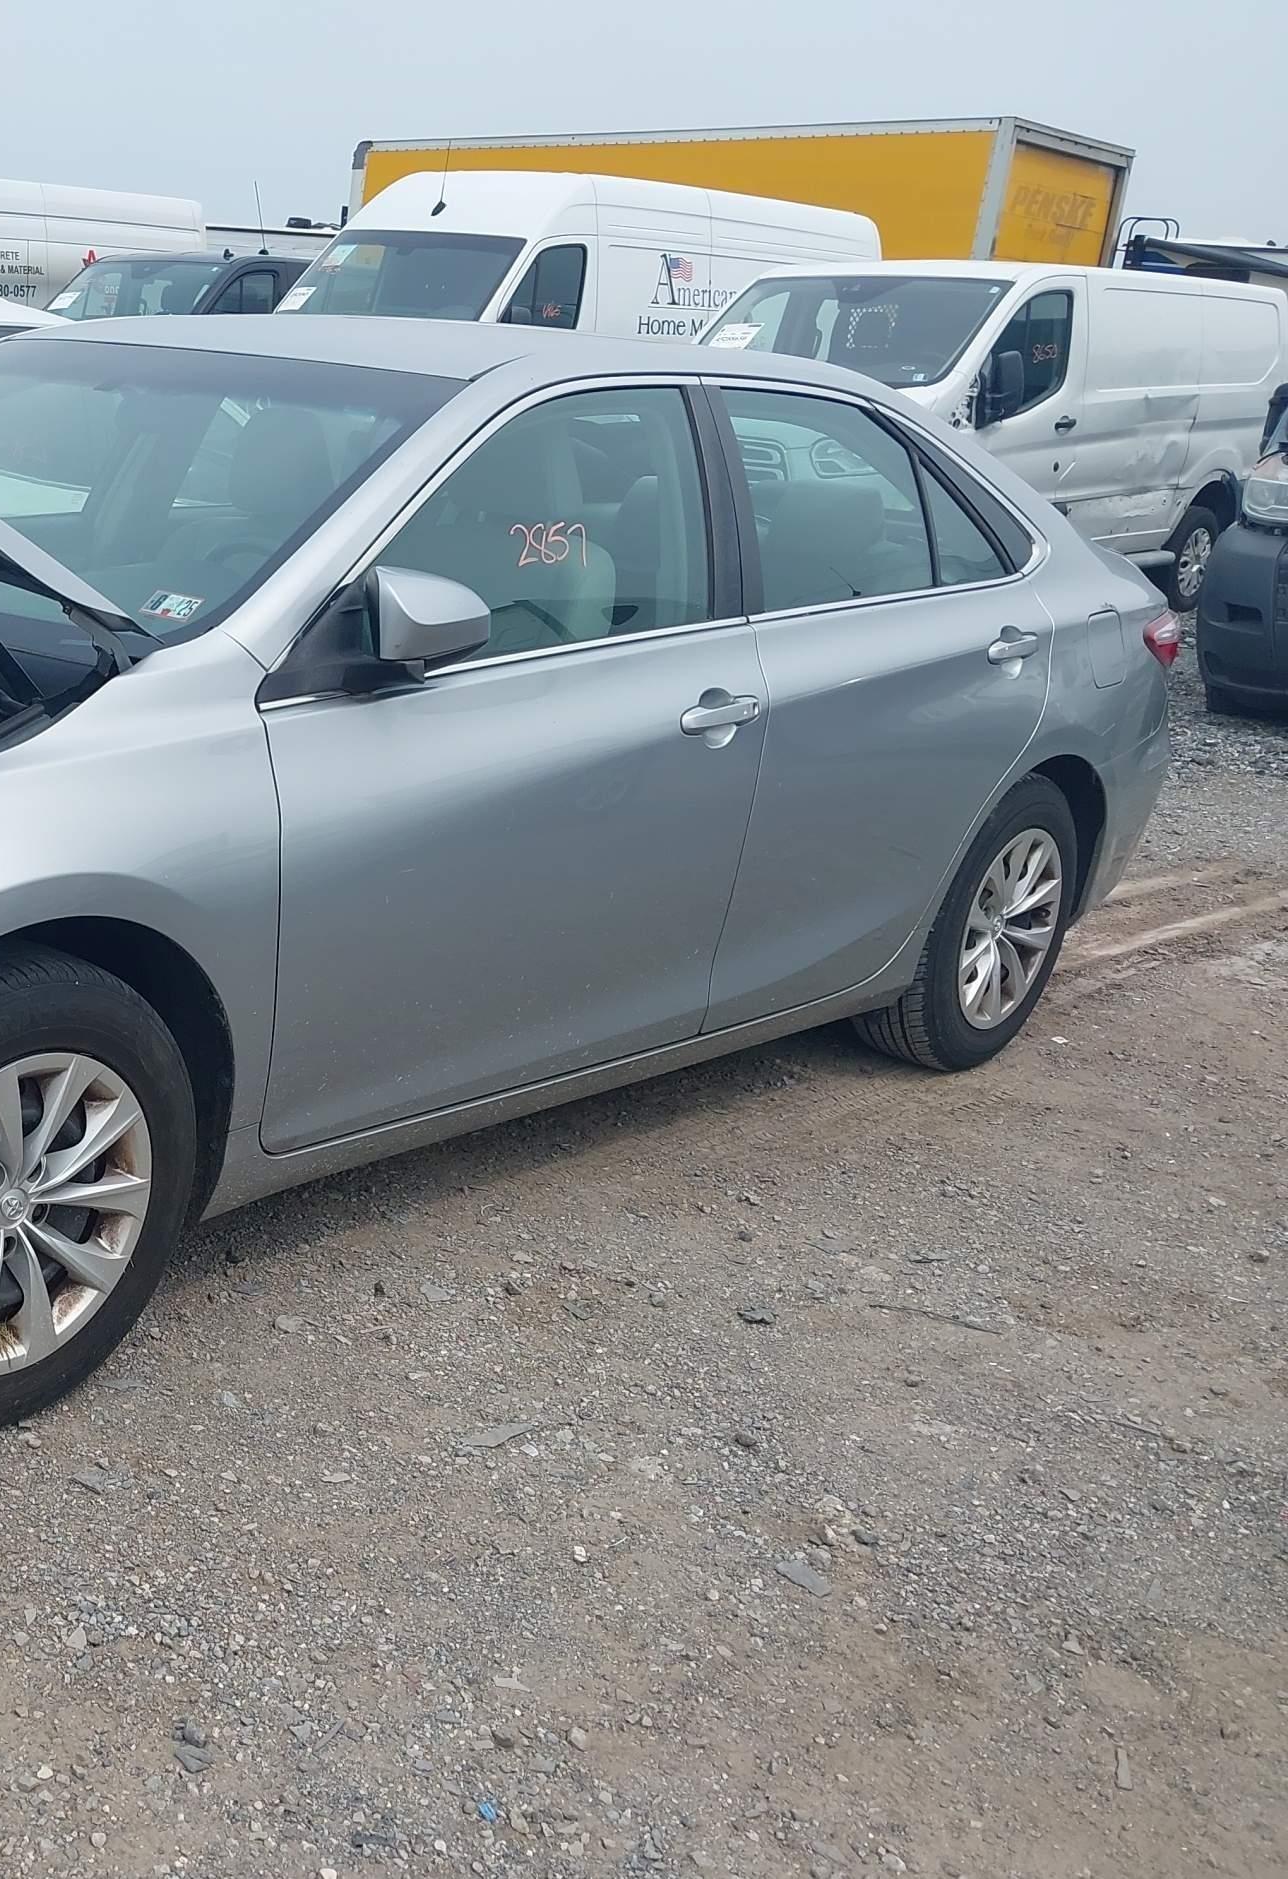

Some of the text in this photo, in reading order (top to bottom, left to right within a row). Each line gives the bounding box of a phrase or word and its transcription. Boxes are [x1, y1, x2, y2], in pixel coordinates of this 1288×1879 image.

[1009, 184, 1097, 226] PENSKE
[0, 264, 6, 274] &
[7, 265, 45, 275] MATERIAL
[637, 315, 704, 336] Home M
[176, 599, 199, 617] 25
